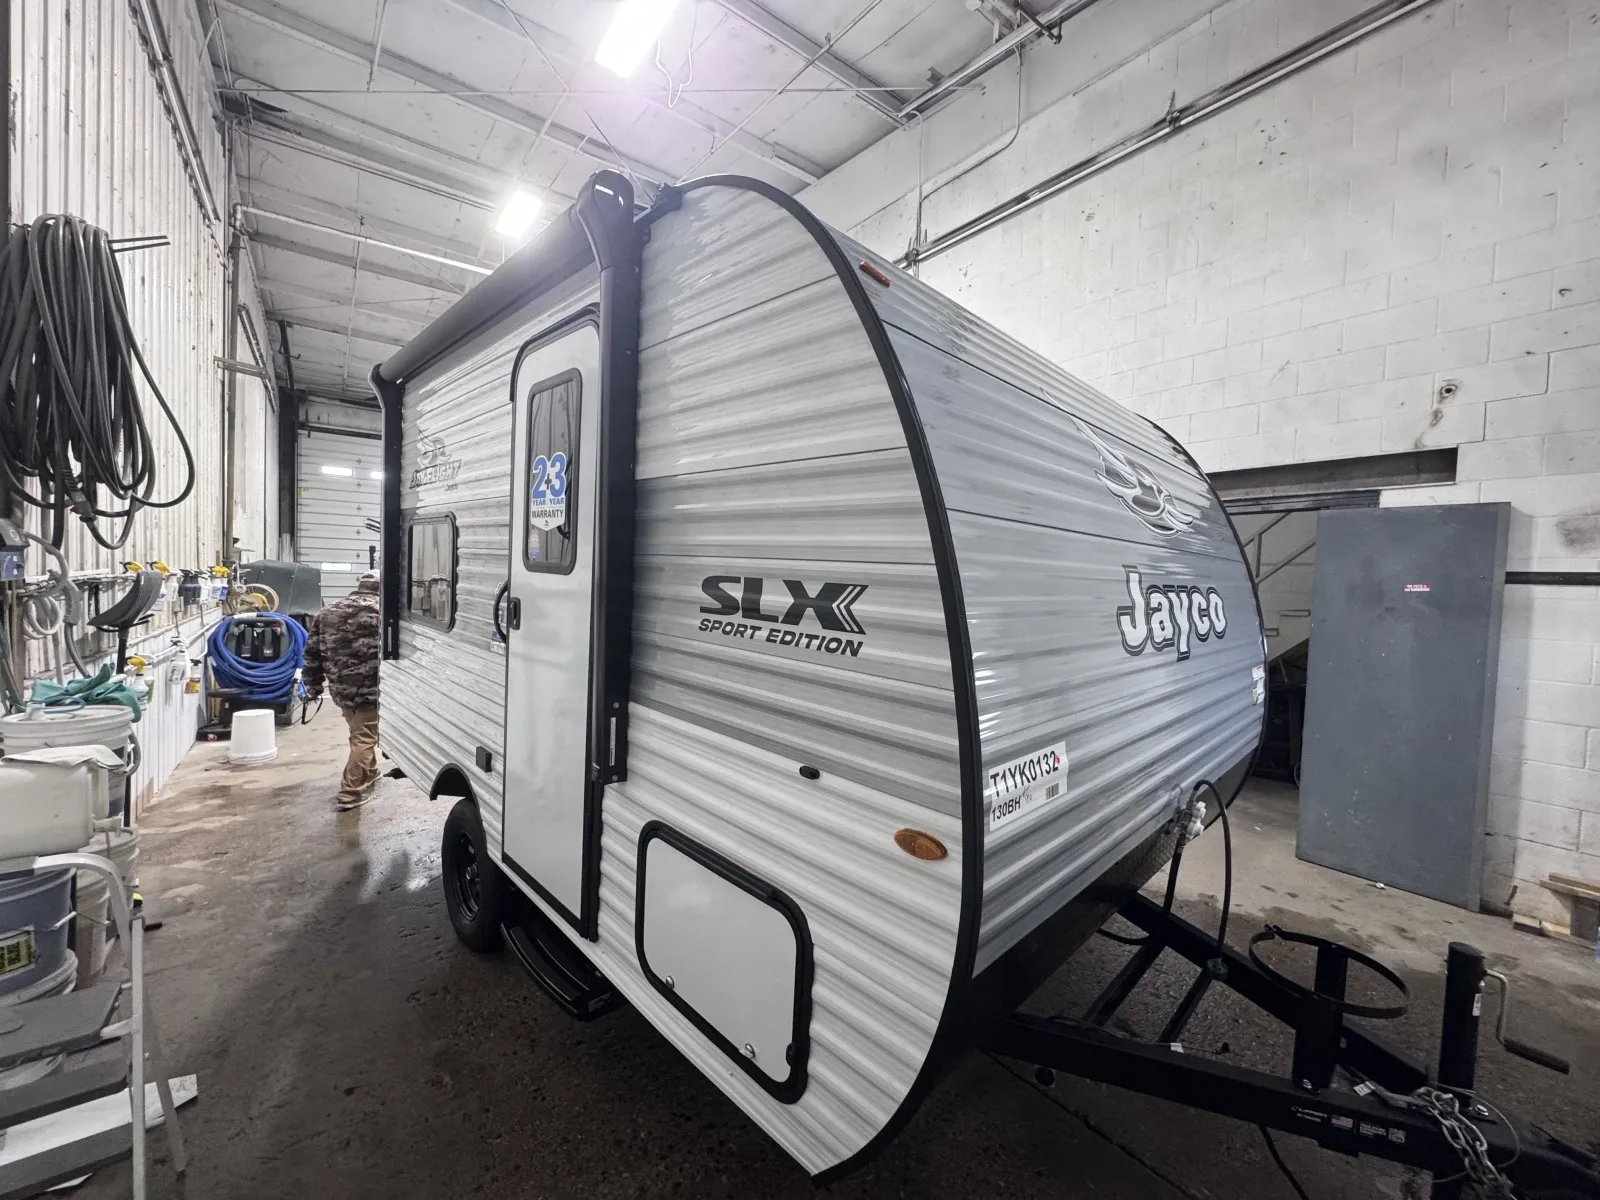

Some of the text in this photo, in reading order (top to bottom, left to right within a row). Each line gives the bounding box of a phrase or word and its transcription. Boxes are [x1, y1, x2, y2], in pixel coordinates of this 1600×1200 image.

[532, 509, 564, 519] WARRANTY
[549, 498, 564, 506] YEAR
[699, 575, 869, 635] SLX
[1116, 564, 1228, 662] Jayco
[698, 618, 864, 657] SPORT EDITION
[990, 750, 1059, 798] T1YK0132
[991, 795, 1022, 822] 130BH
